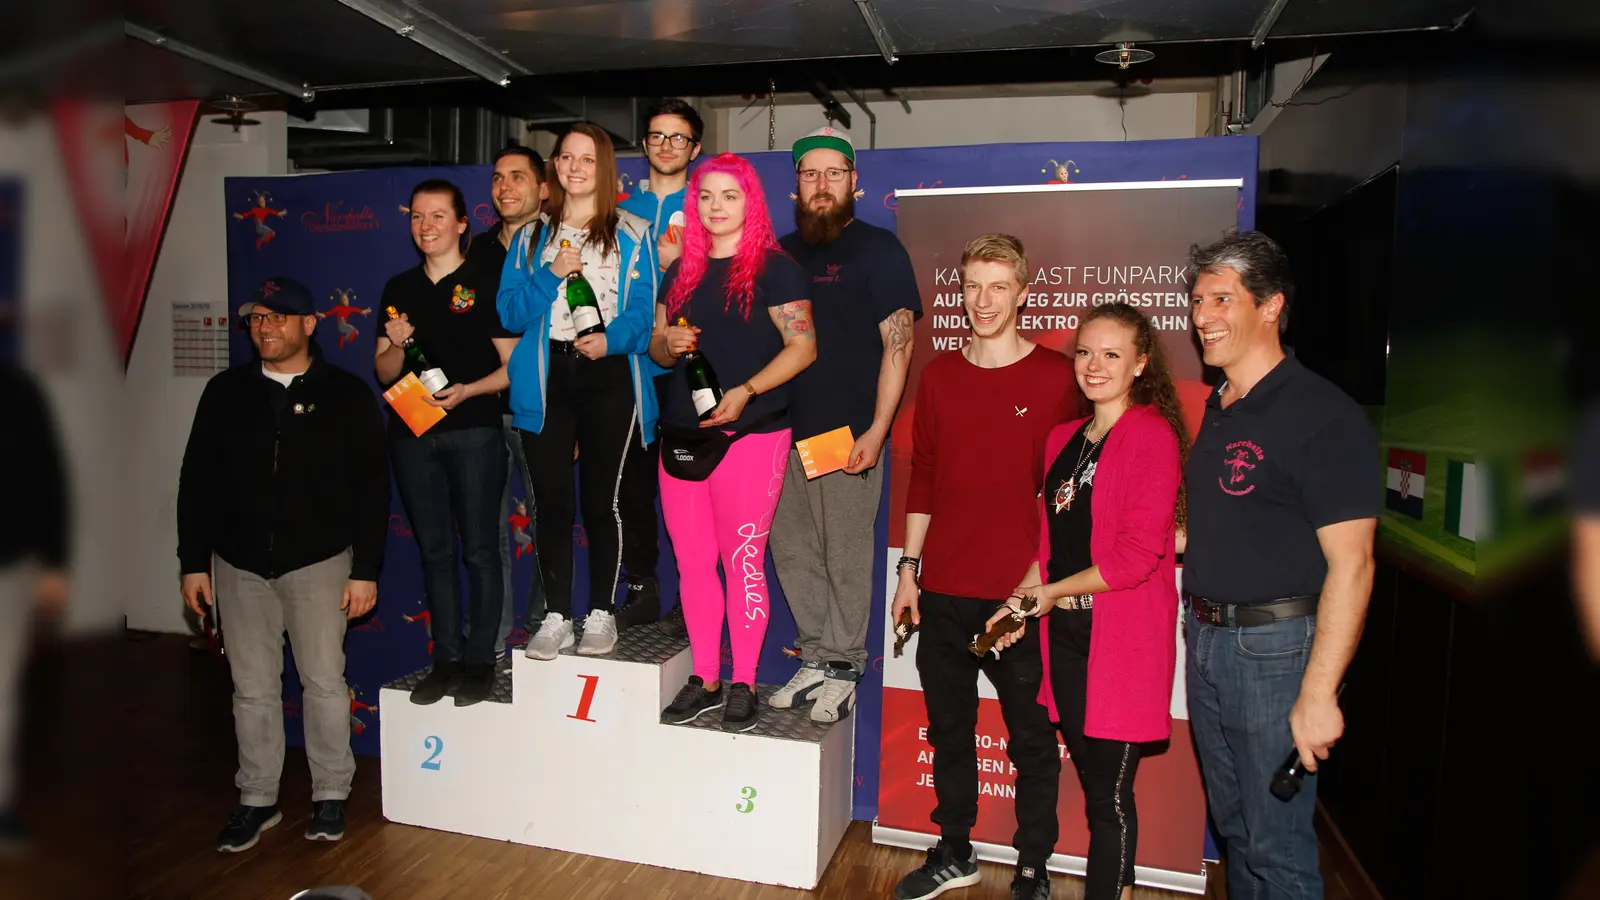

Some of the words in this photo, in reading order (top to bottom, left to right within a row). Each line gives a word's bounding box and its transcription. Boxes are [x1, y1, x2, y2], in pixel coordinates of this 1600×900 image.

[1083, 265, 1188, 285] FUNPARK
[1052, 292, 1088, 307] ZUR
[1091, 288, 1189, 308] GRÖSSTEN
[566, 673, 599, 723] 1
[420, 735, 444, 771] 2
[735, 786, 758, 814] 3
